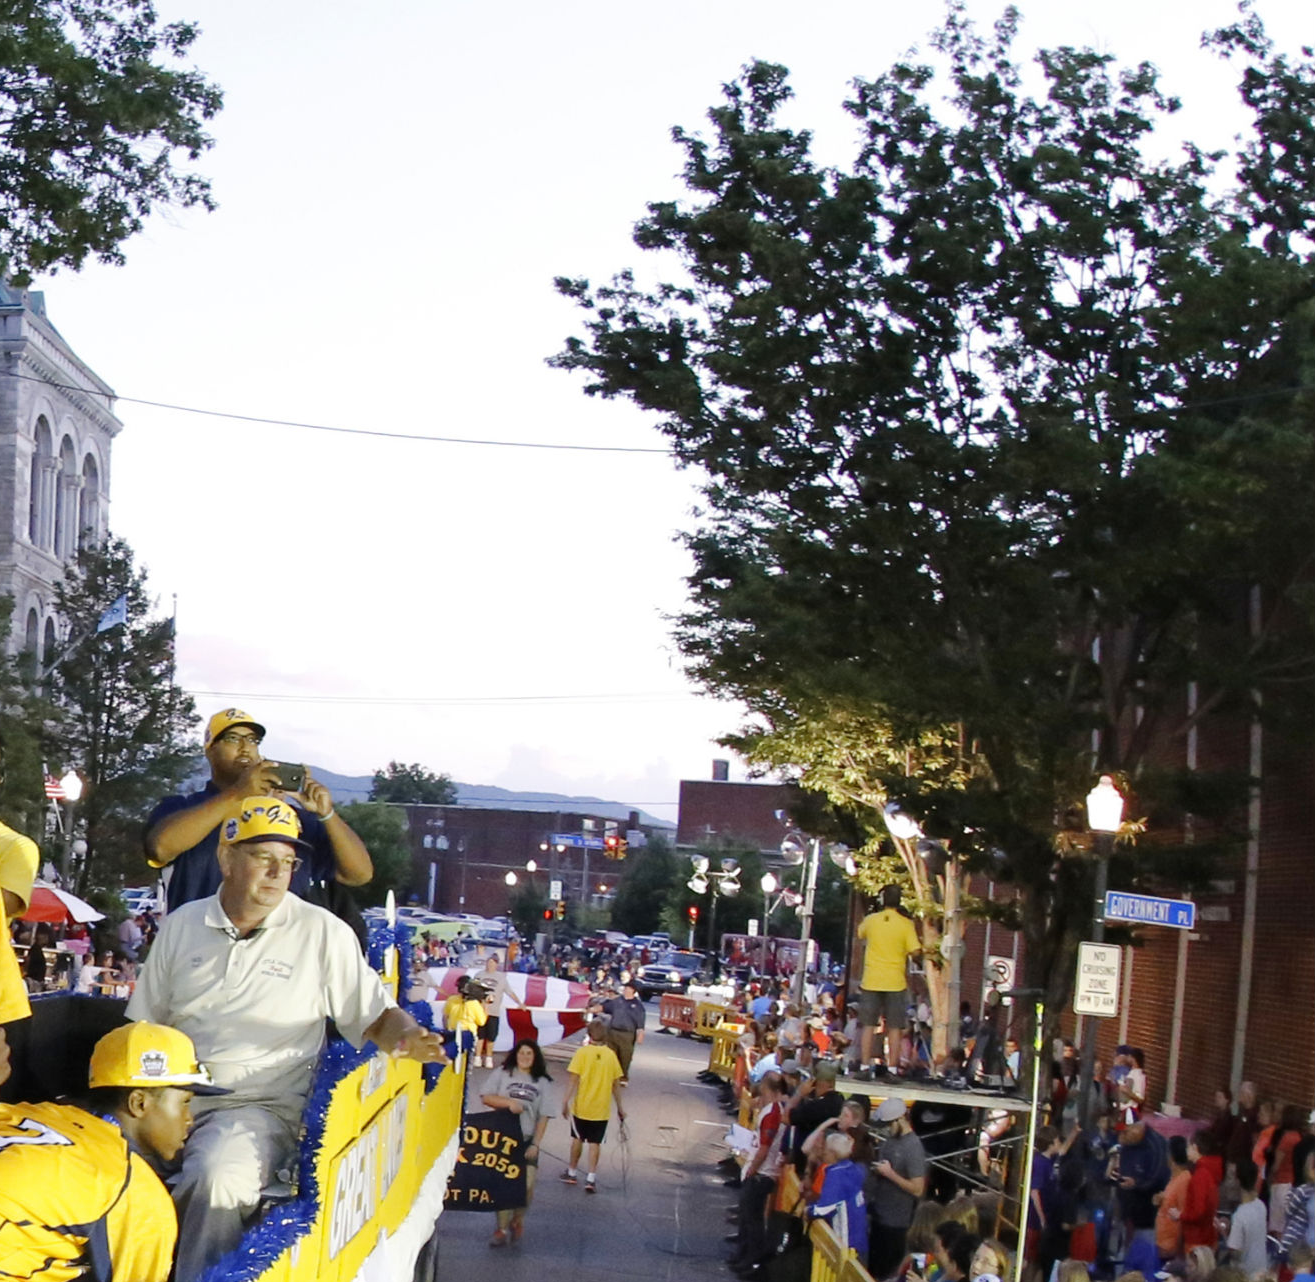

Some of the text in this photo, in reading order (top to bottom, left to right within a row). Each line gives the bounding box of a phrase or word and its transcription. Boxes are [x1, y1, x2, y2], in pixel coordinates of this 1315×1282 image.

[1110, 896, 1171, 922] GOVERNMENT
[1094, 951, 1106, 962] NO
[471, 1152, 521, 1180] 2059
[469, 1188, 495, 1205] PA.
